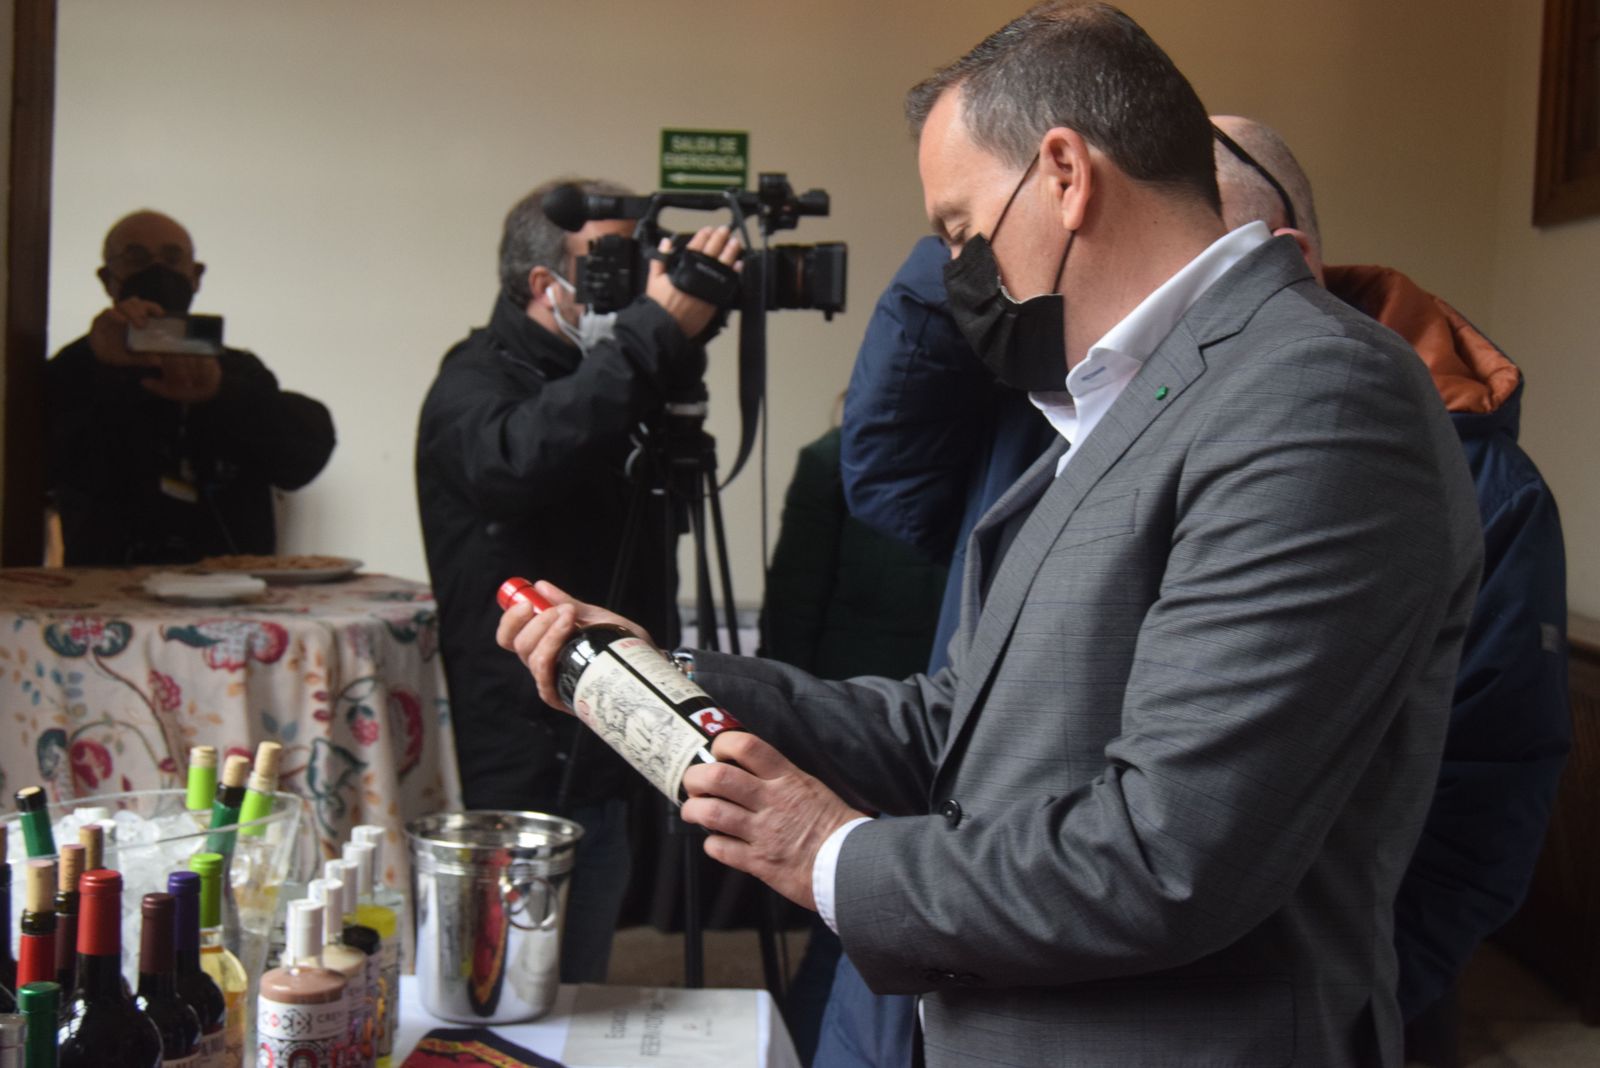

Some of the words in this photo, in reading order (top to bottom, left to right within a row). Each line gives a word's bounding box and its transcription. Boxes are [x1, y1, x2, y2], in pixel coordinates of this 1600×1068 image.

[671, 135, 717, 152] SALIDA
[719, 137, 737, 153] DE
[663, 153, 743, 170] EMERGENCIA
